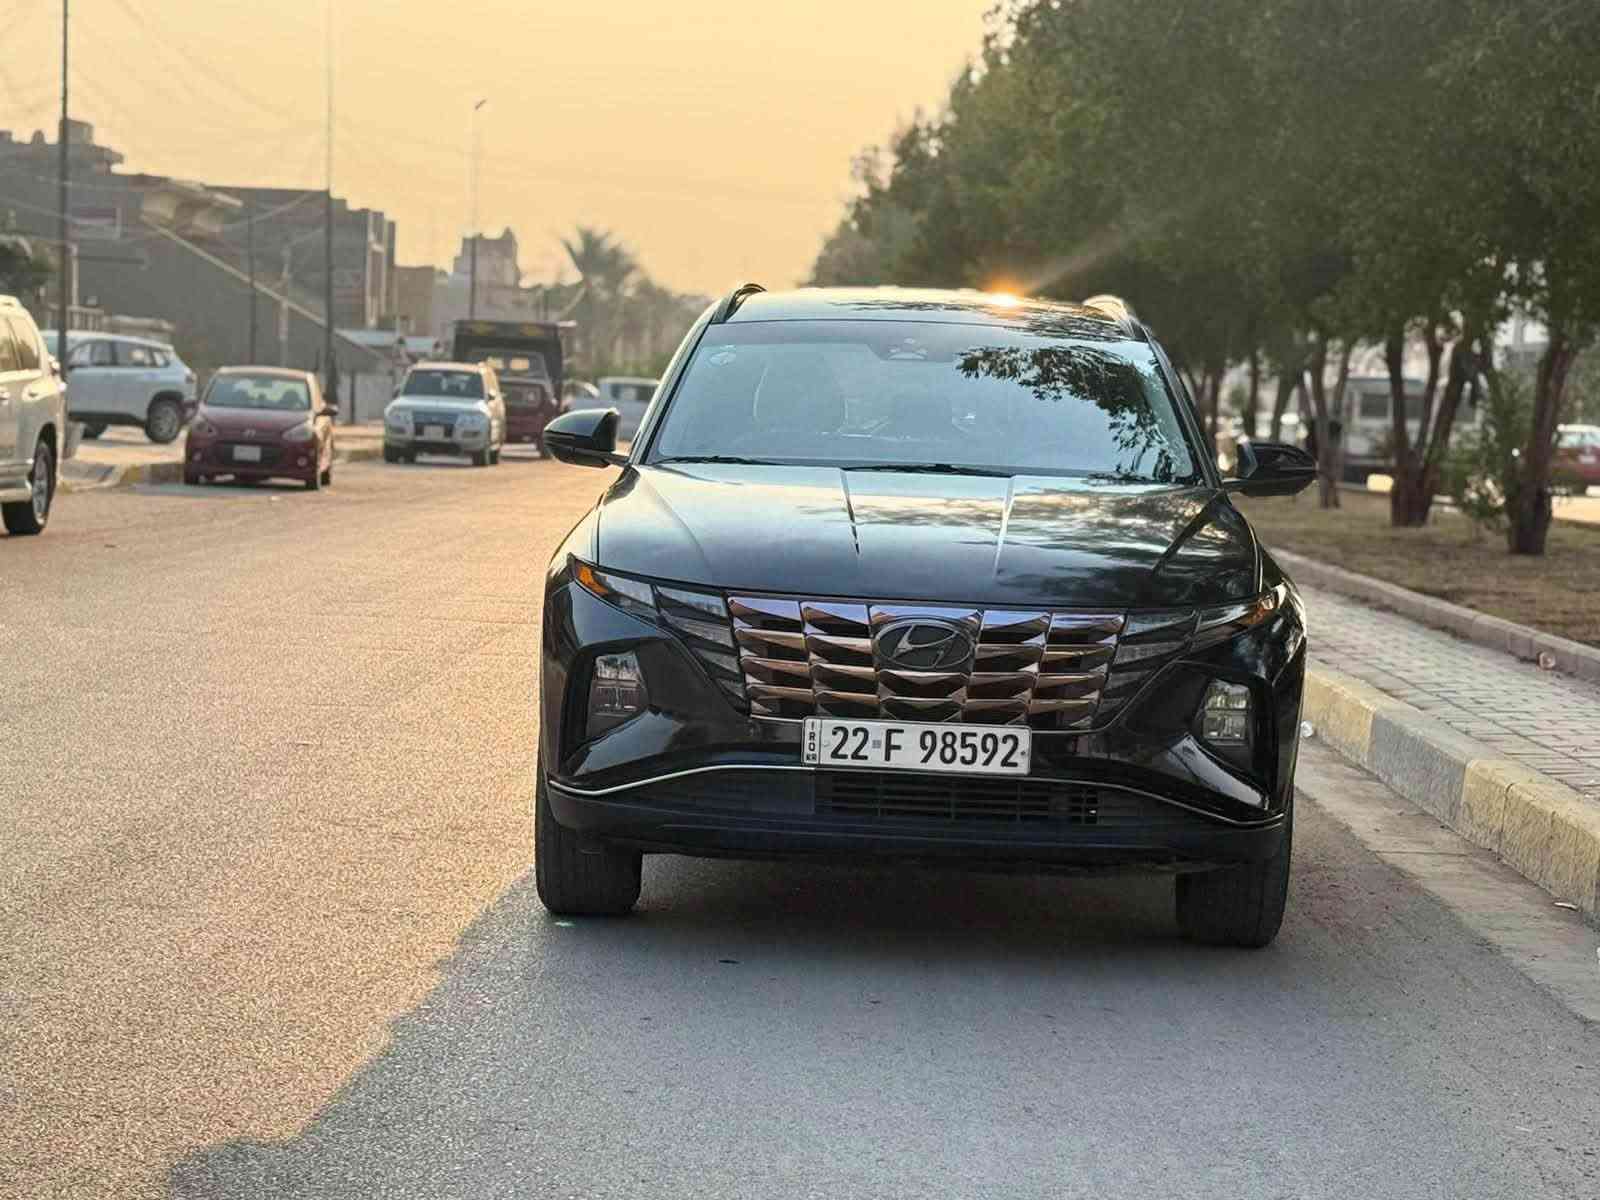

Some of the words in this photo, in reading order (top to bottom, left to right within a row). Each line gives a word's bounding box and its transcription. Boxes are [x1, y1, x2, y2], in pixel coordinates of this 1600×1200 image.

[831, 726, 869, 760] 22
[884, 729, 904, 761] F
[920, 730, 1019, 767] 98592
